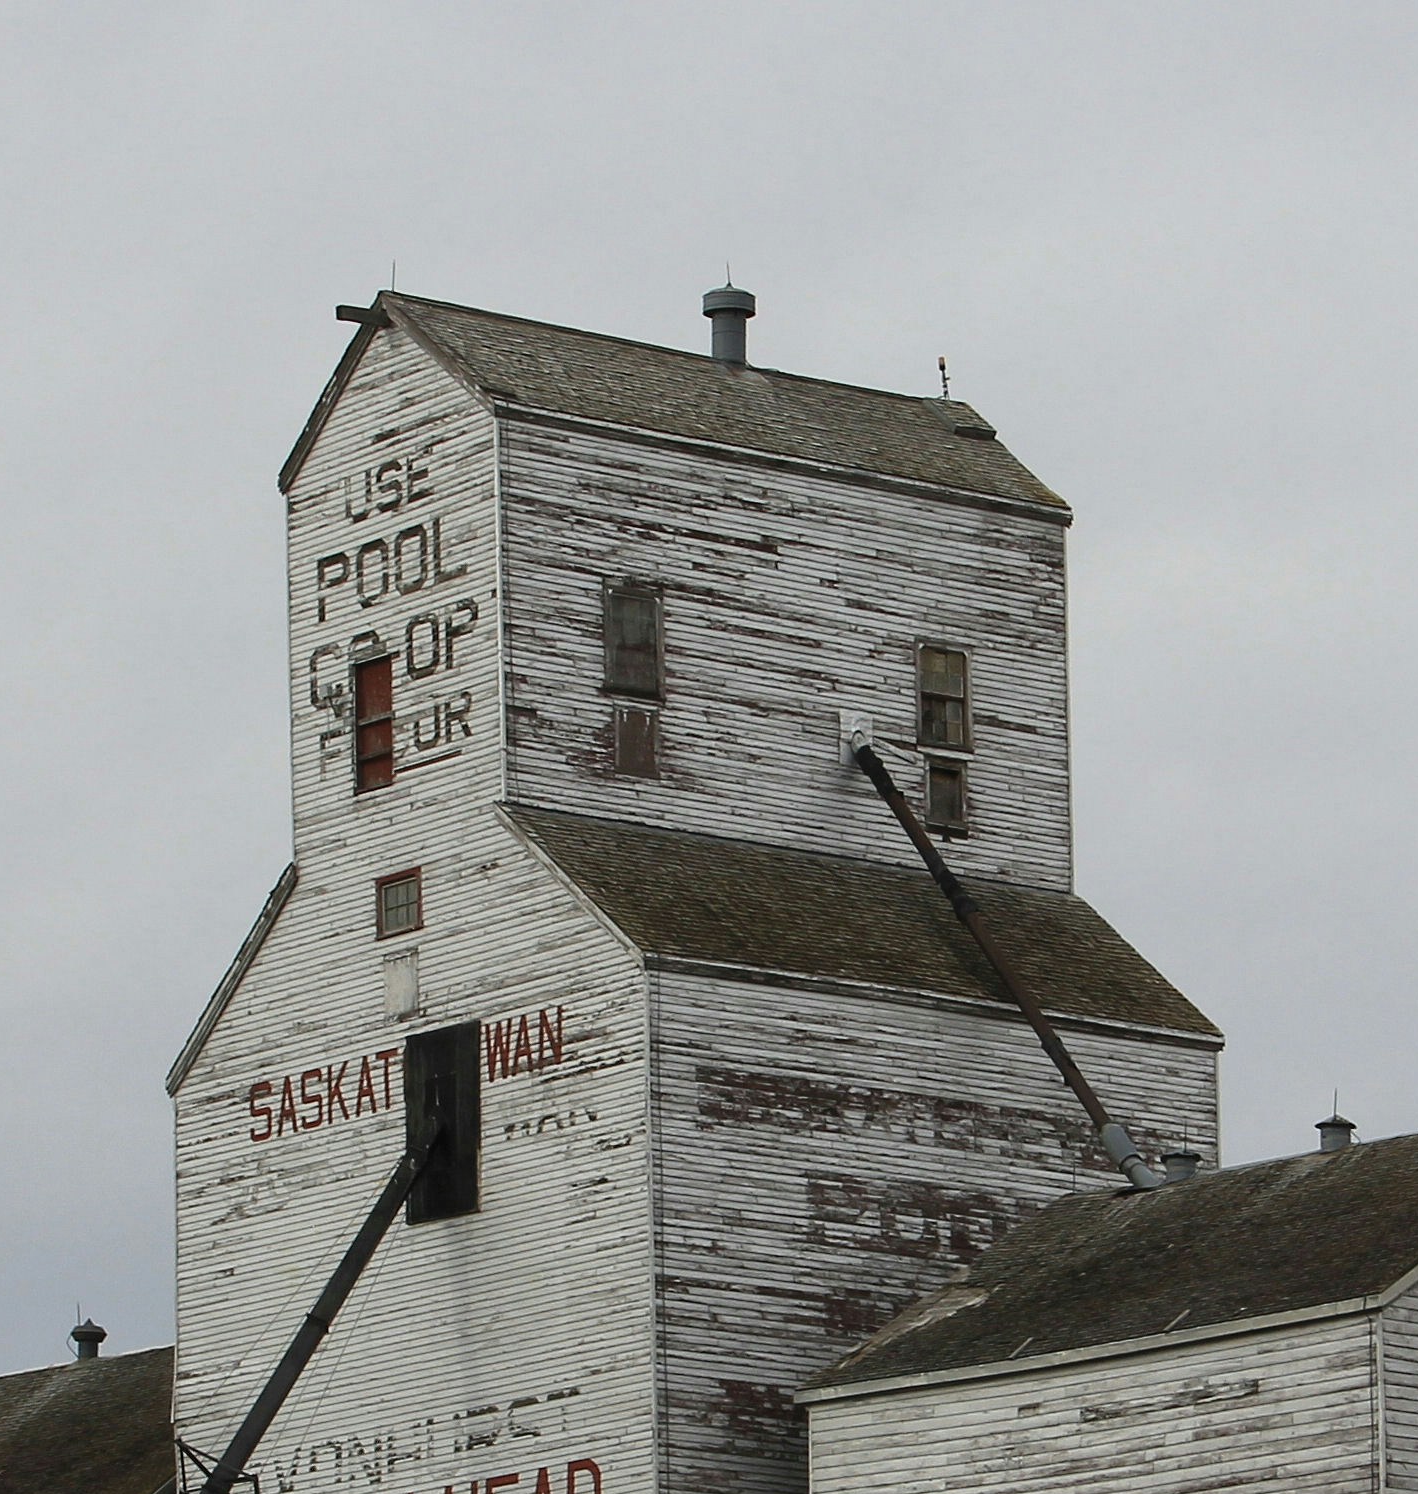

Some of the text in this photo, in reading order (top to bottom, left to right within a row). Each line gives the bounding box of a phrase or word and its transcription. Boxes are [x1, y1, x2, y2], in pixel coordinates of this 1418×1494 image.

[344, 446, 434, 524] USE
[317, 517, 468, 622] POOL
[249, 1005, 565, 1142] SASKATWAN
